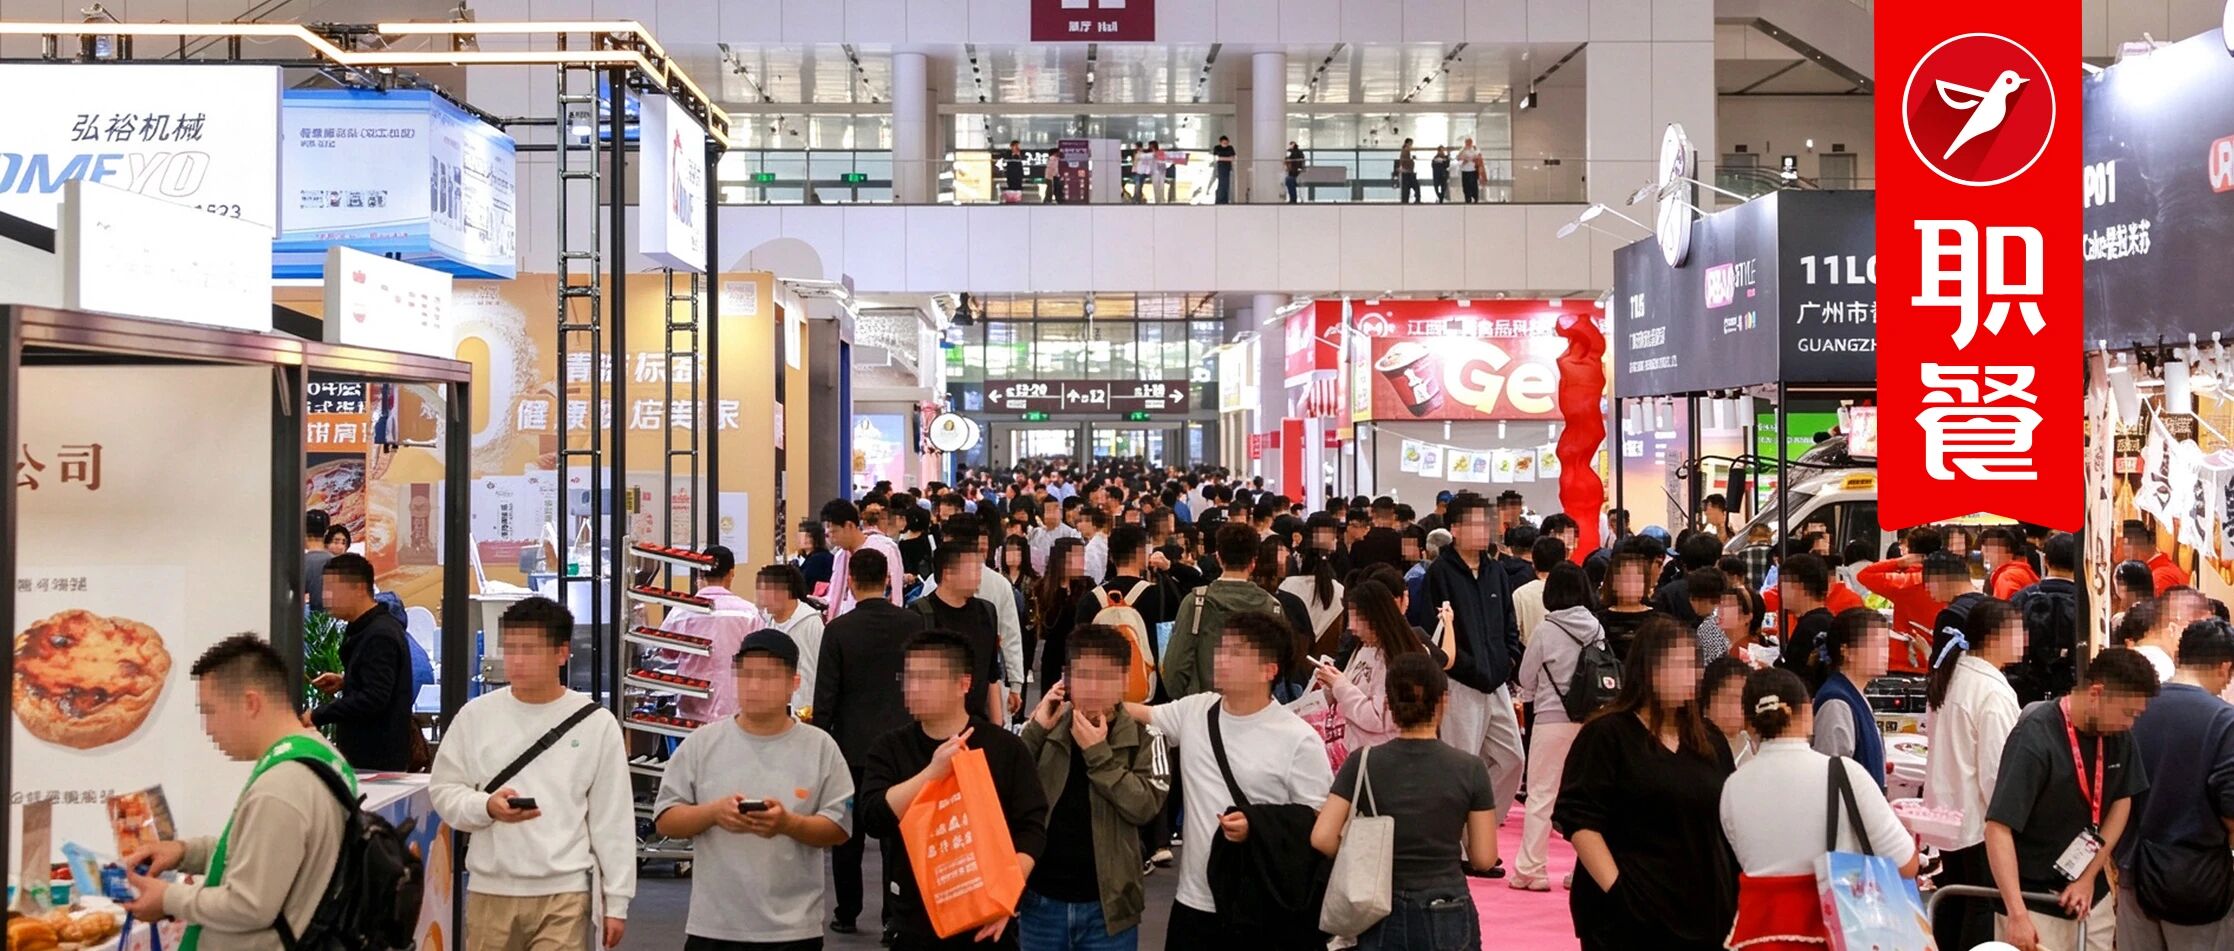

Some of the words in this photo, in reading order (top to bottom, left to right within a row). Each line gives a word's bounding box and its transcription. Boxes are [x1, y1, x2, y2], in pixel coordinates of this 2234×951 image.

[71, 113, 206, 142] 弘裕机械
[1796, 301, 1876, 325] 广州市
[16, 443, 103, 491] 公司
